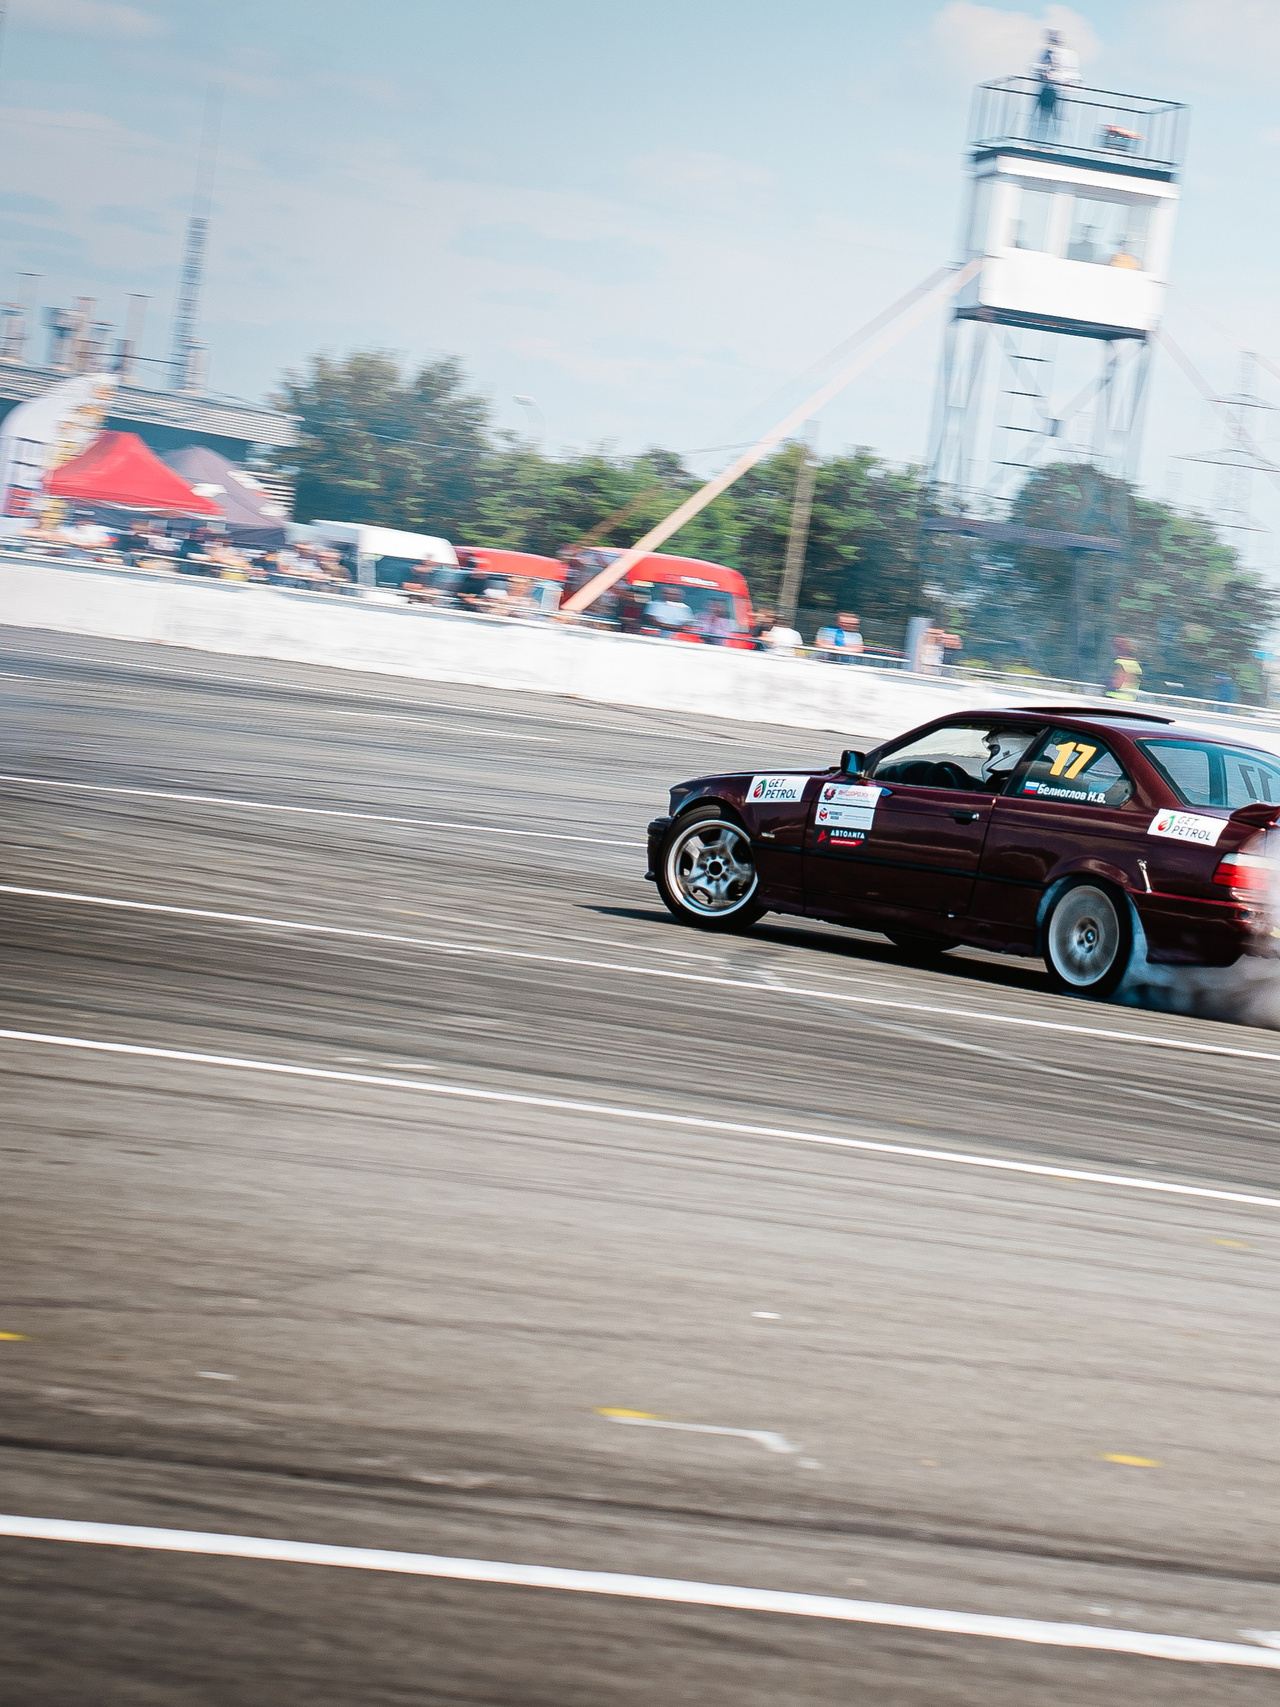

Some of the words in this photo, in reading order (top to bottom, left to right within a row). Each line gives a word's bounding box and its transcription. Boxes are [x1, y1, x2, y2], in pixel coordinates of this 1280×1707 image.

[1049, 741, 1097, 780] 17
[768, 778, 787, 788] GET
[764, 788, 797, 799] PETROL
[1037, 783, 1087, 800] Белиоглов
[1087, 792, 1107, 804] Н.В.
[1177, 816, 1200, 826] GET
[1171, 826, 1212, 841] PETROL
